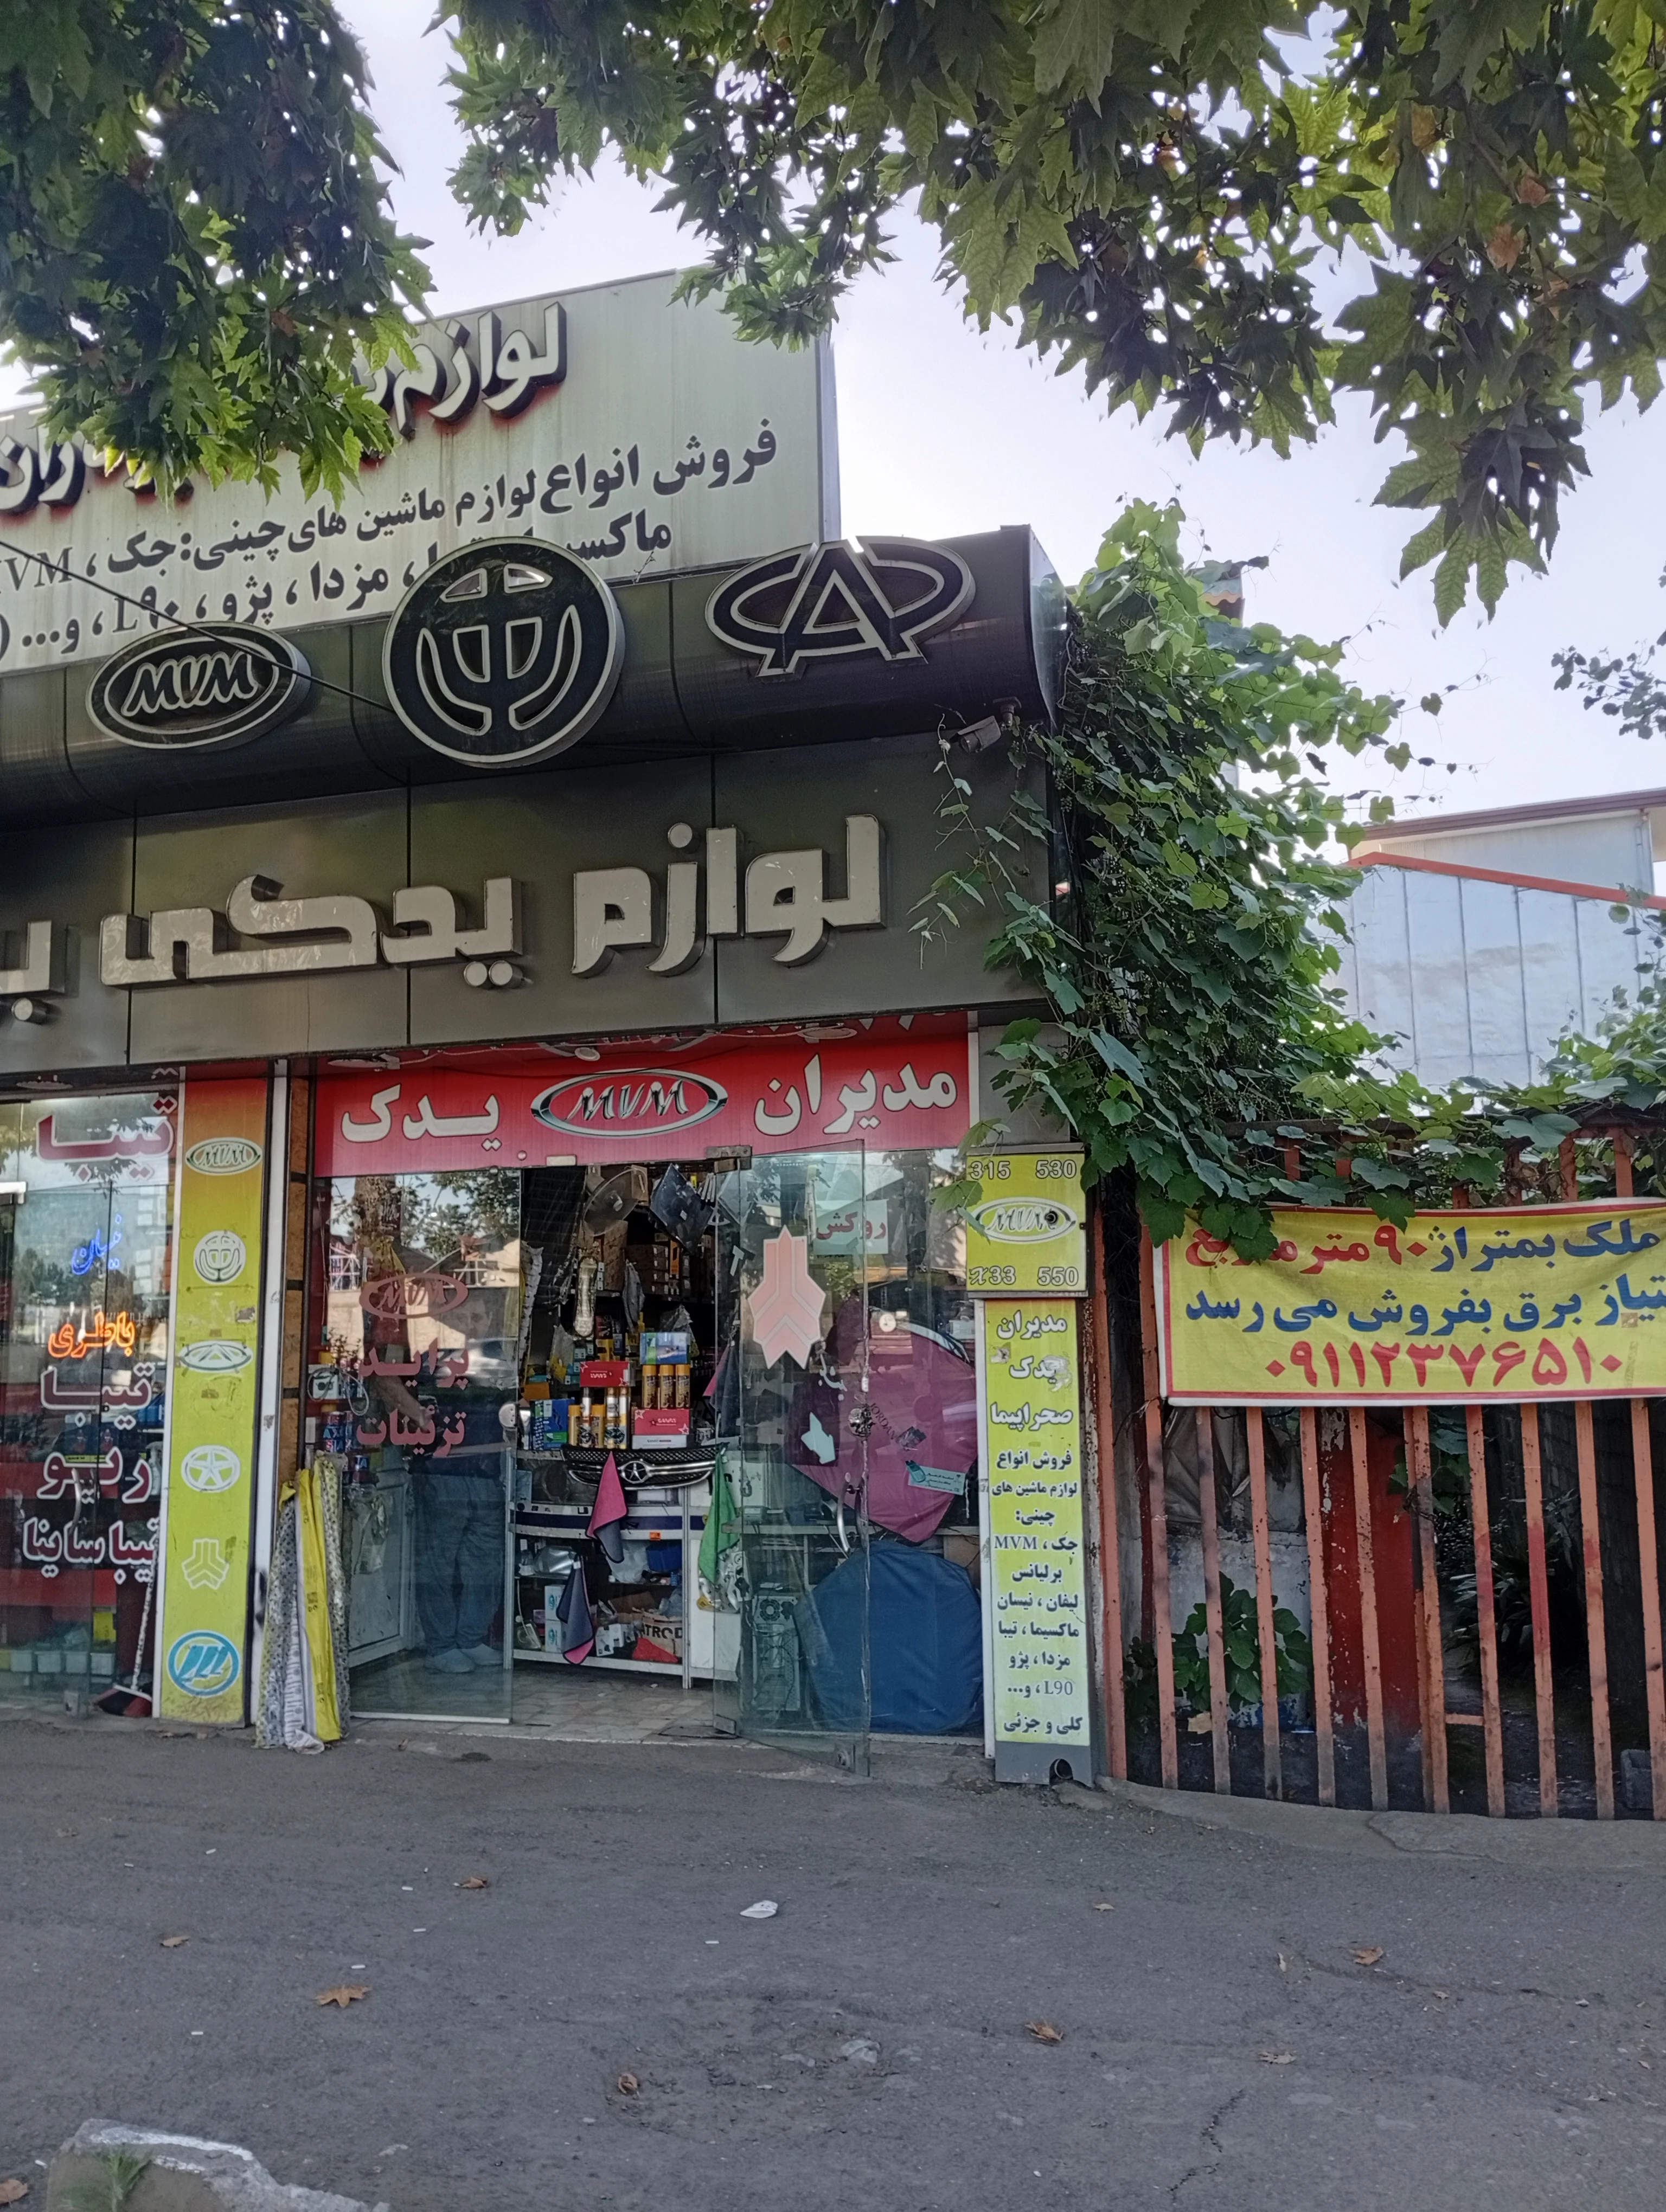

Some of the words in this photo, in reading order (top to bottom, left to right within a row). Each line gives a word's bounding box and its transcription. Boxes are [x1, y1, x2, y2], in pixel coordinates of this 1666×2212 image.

[393, 301, 567, 441] لوازم
[653, 418, 777, 496] فروش
[456, 469, 537, 526] لوازم
[540, 444, 640, 514] انواع
[287, 505, 347, 553] های
[357, 488, 446, 542] ماشین
[0, 546, 73, 592] VM
[309, 561, 388, 610] مزدا
[221, 575, 273, 623] پژو
[121, 651, 258, 716] MVM
[569, 813, 885, 976] لوازم
[99, 874, 522, 989] یدکی
[564, 1082, 689, 1121] MVM
[754, 1052, 958, 1136] مدیران
[341, 1083, 502, 1152] یدک
[36, 1095, 178, 1183] تیبا
[970, 1160, 1011, 1180] 315
[1035, 1160, 1077, 1179] 530
[1299, 1233, 1370, 1274] متر
[1563, 1218, 1661, 1257] ملک
[1036, 1266, 1079, 1286] 550
[996, 1310, 1067, 1339] مدیران
[1349, 1289, 1491, 1336] بفروش
[1503, 1293, 1582, 1332] برق
[48, 1311, 135, 1358] باطری
[358, 1337, 469, 1390] پراید
[1265, 1336, 1623, 1388] ۰۹۱۱۲۳۷۶۵۱۰
[40, 1362, 155, 1428] تیبا
[990, 1401, 1074, 1431] صحراپیما
[36, 1446, 152, 1504] ریو
[996, 1450, 1029, 1470] انواع
[1033, 1450, 1073, 1470] فروش
[991, 1481, 1013, 1497] های
[1015, 1481, 1047, 1499] ماشین
[1049, 1481, 1078, 1498] لوازم
[994, 1535, 1038, 1551] MVM
[1052, 1535, 1078, 1555] جک
[1012, 1564, 1063, 1582] برلیانس
[997, 1591, 1033, 1610] نیسان
[1046, 1593, 1079, 1612] لیفان
[998, 1621, 1018, 1638] تیبا
[1030, 1621, 1080, 1639] ماکسیما
[1009, 1651, 1029, 1670] پژو
[1042, 1651, 1071, 1670] مزدا
[1044, 1681, 1073, 1696] L90
[1057, 1716, 1082, 1734] کلی
